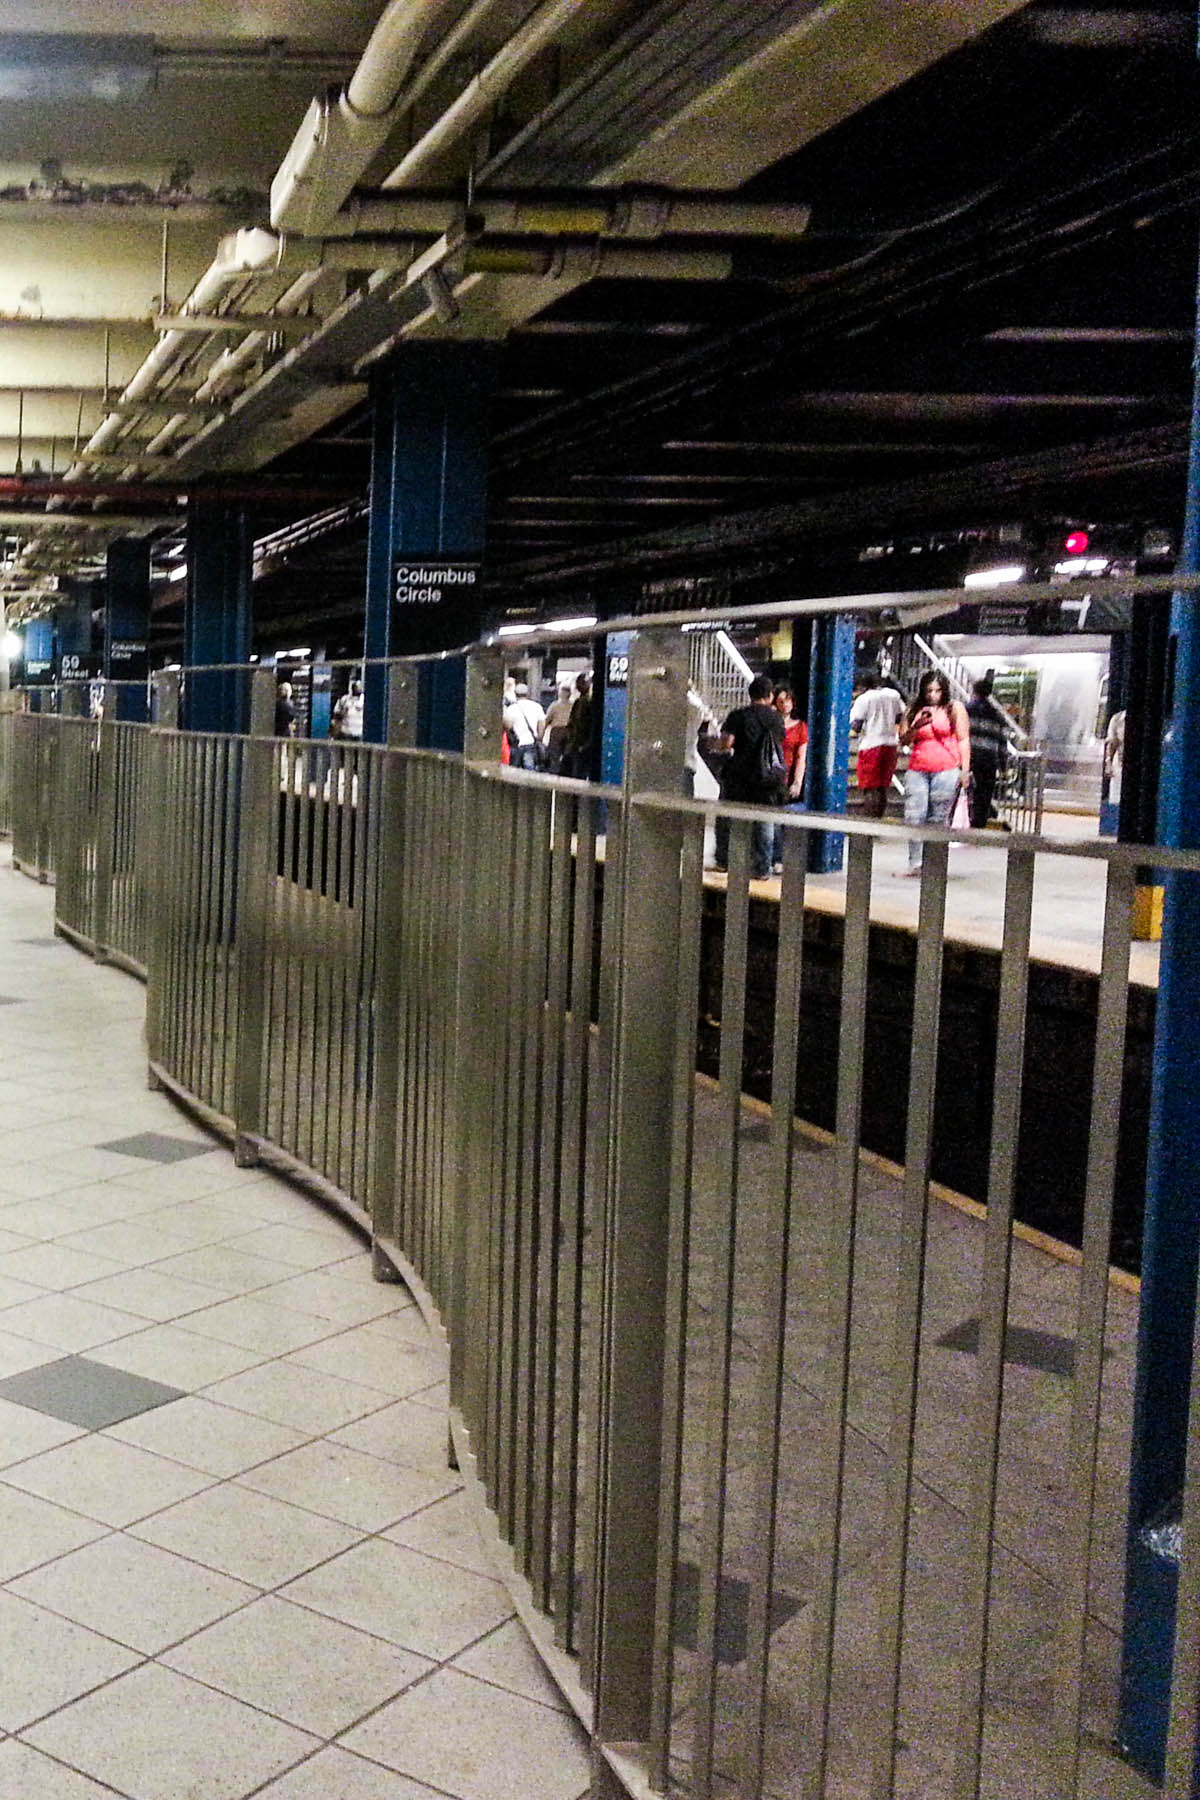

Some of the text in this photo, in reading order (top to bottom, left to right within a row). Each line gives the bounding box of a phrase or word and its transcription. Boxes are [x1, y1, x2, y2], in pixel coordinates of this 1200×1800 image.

[397, 567, 477, 586] Columbus
[396, 586, 443, 605] Circle
[62, 655, 80, 670] 59
[609, 657, 629, 672] 59
